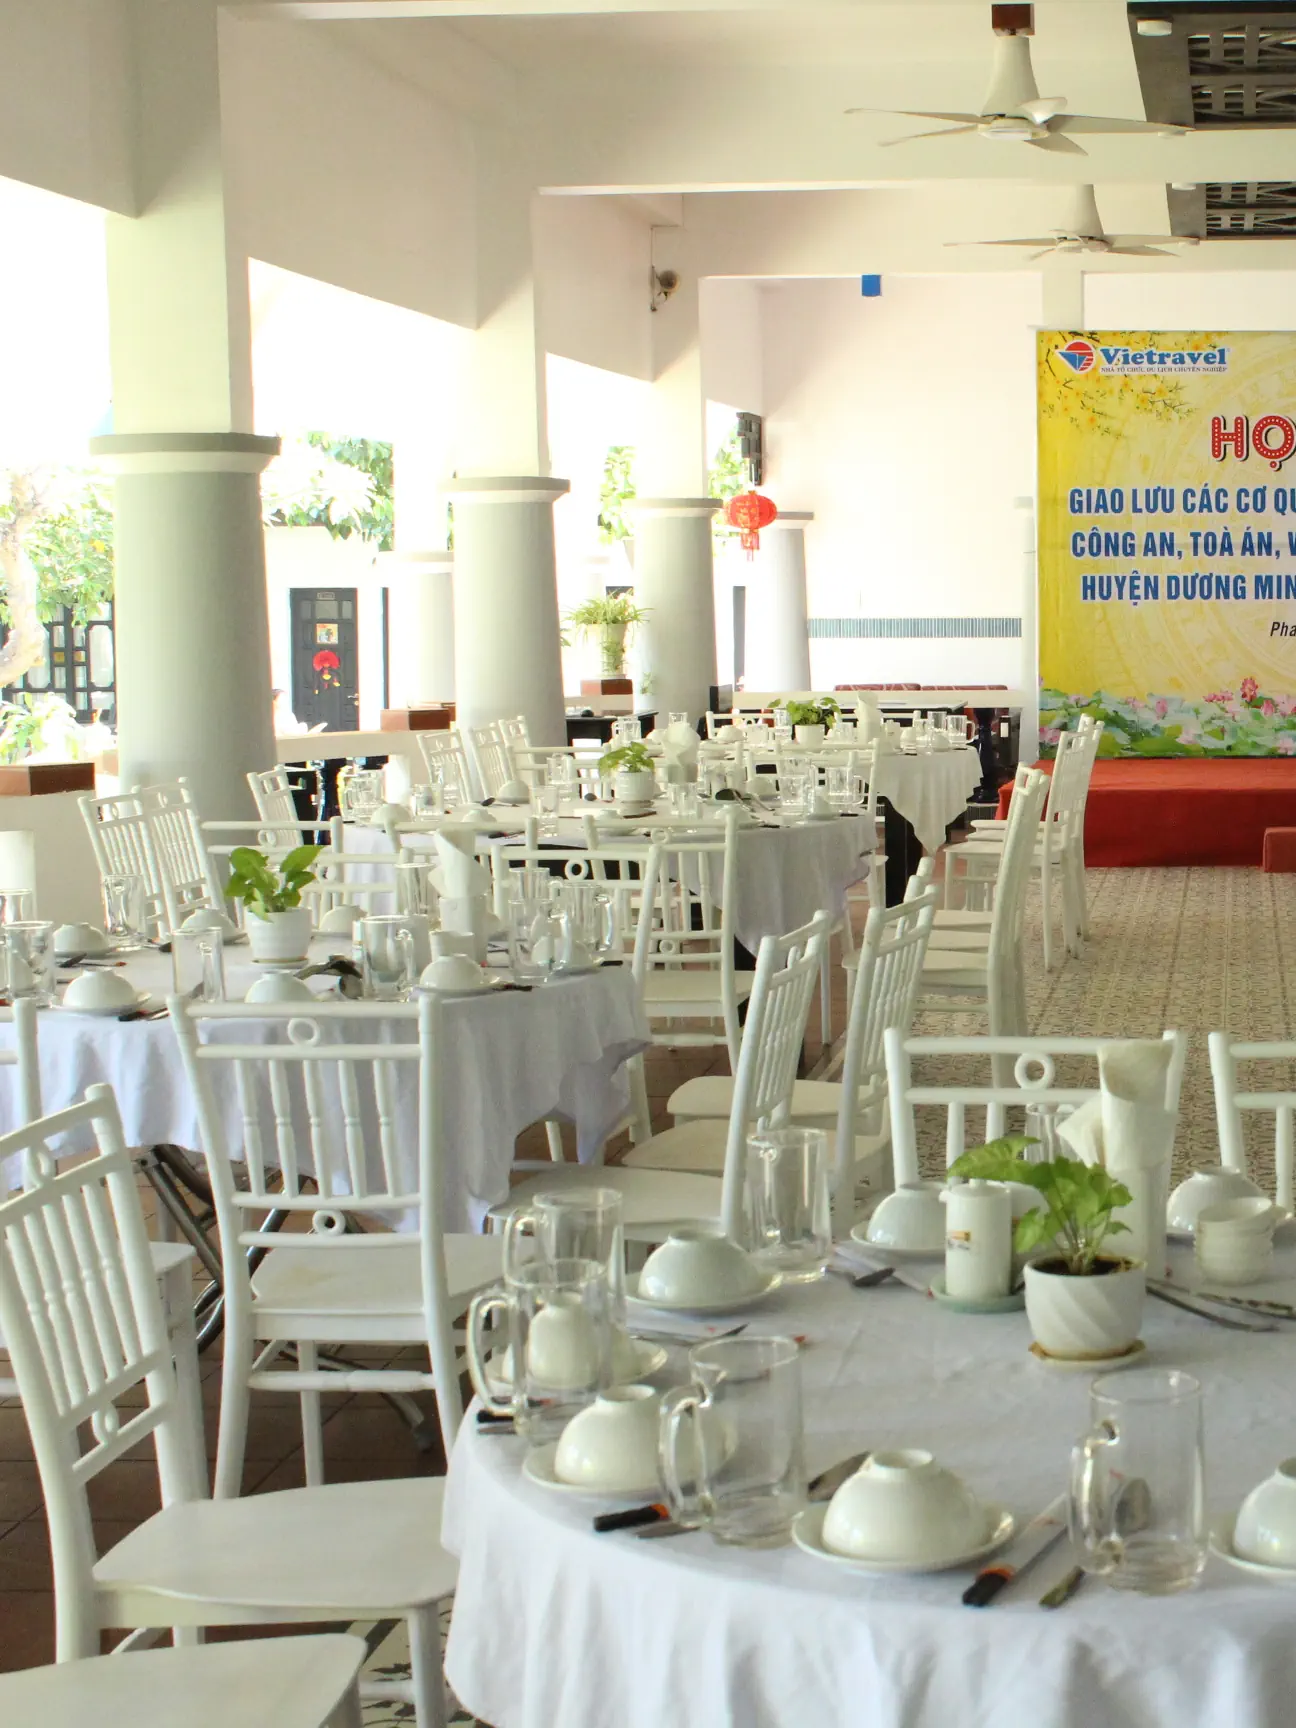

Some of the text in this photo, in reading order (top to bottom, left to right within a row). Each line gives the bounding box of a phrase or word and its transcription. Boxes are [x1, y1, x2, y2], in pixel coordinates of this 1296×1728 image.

[1100, 347, 1227, 365] Vietravel
[1069, 487, 1125, 513] GIAO
[1131, 486, 1175, 513] LƯU
[1182, 484, 1229, 513] CÁC
[1236, 485, 1268, 513] CƠ
[1071, 527, 1137, 557] CÔNG
[1143, 531, 1183, 560] AN,
[1190, 526, 1234, 557] TOÀ
[1241, 526, 1281, 560] ÁN,
[1081, 569, 1160, 606] HUYỆN
[1166, 573, 1248, 601] DƯƠNG
